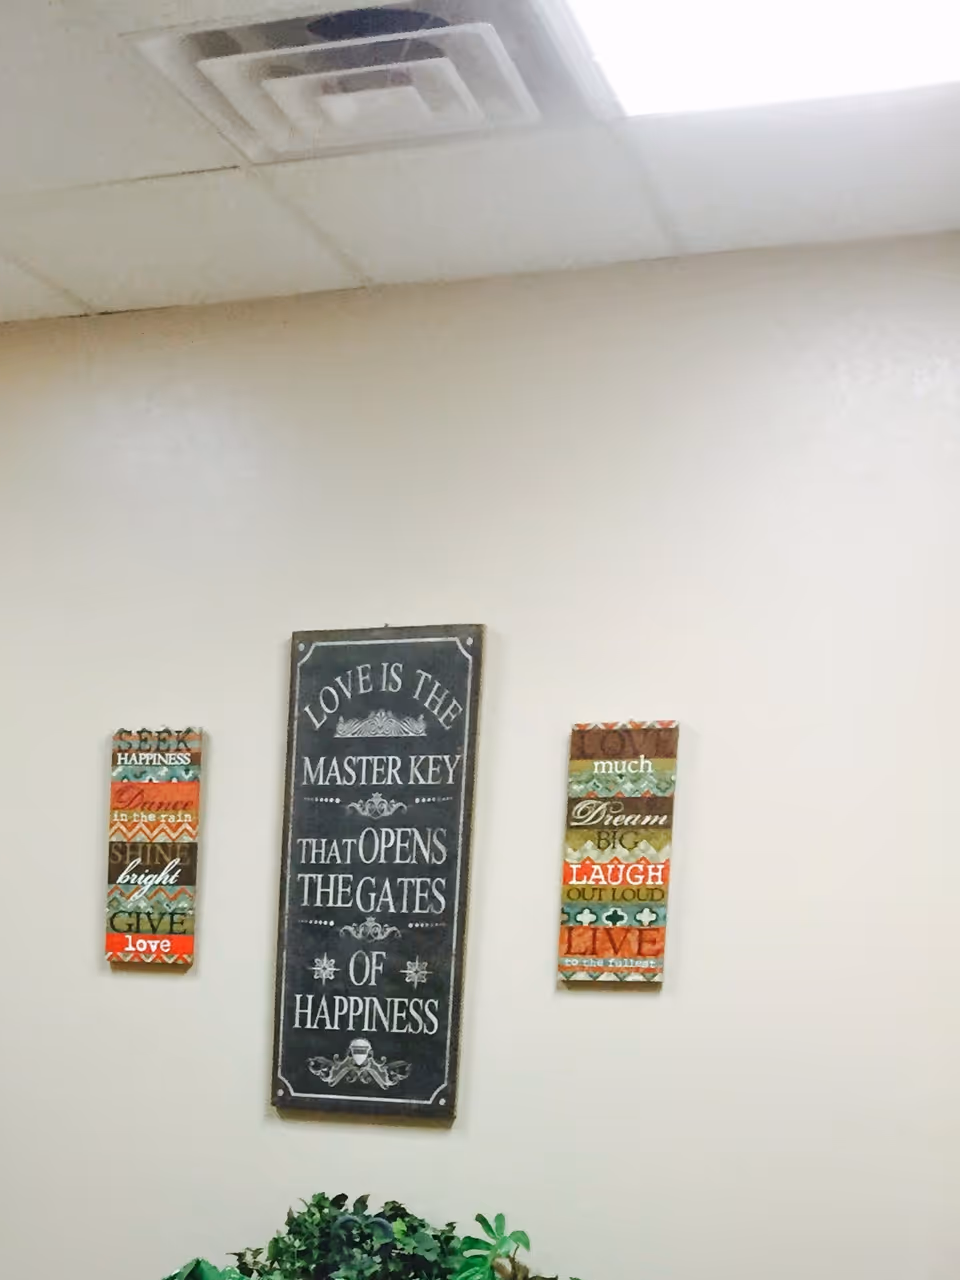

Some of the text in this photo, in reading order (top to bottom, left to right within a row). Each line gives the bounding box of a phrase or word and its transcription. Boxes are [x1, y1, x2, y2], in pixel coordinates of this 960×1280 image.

[304, 662, 463, 731] LOVE IS THE
[117, 730, 191, 751] SEEK
[117, 752, 191, 766] HAPPINESS
[302, 754, 462, 786] MASTER KEY
[593, 754, 653, 773] much
[113, 810, 192, 823] in the rain
[570, 799, 667, 826] Dream
[297, 827, 448, 865] THAT OPENS
[597, 830, 639, 851] BIG
[110, 843, 191, 866] SHINE
[116, 857, 181, 902] bright
[569, 864, 665, 885] LAUGH
[297, 873, 446, 915] THE GATES
[567, 887, 664, 902] OUT LOUD
[110, 910, 188, 934] GIVE
[124, 935, 171, 952] love
[564, 926, 661, 956] LIVE
[349, 950, 386, 986] OF
[565, 958, 579, 966] to
[293, 993, 439, 1035] HAPPINESS
